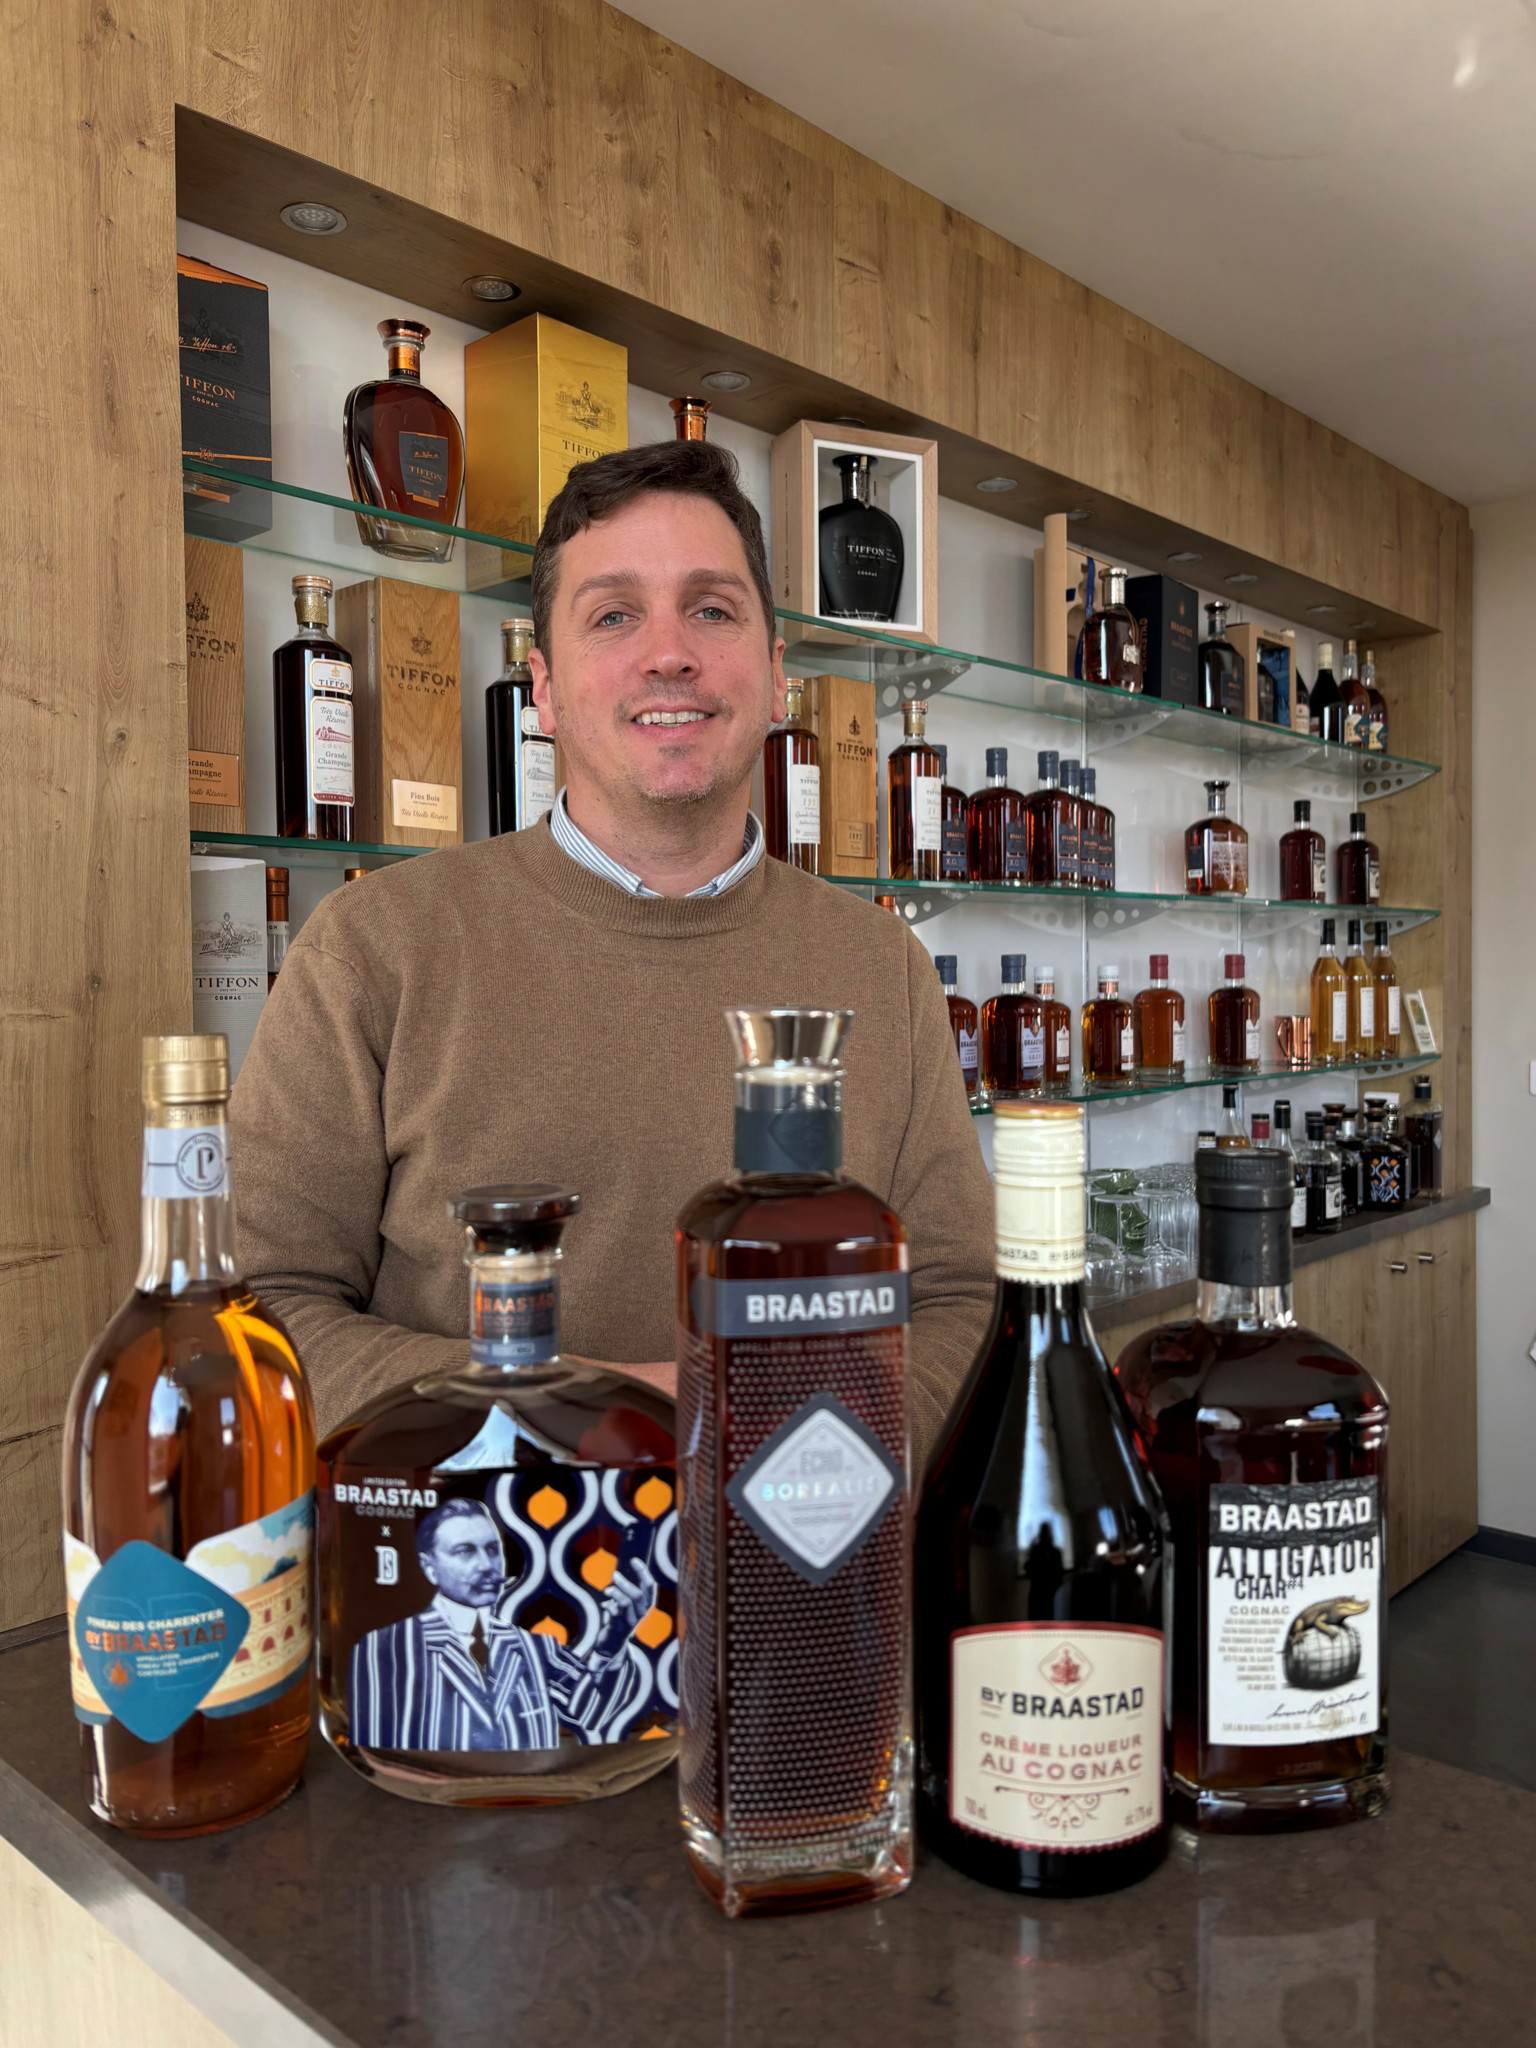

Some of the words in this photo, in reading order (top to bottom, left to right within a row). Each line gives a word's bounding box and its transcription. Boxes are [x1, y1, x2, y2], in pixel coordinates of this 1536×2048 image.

[180, 374, 235, 400] IFFON
[847, 544, 885, 556] TIFFON
[187, 634, 236, 655] FFON
[191, 651, 225, 663] GNAC
[318, 679, 350, 689] TIFFON
[387, 664, 456, 688] TIFFON
[398, 683, 446, 696] COGNAC
[837, 742, 873, 757] TIFFON
[188, 769, 222, 778] mpagne
[195, 977, 259, 988] TIFFON
[747, 1287, 895, 1323] BRAASTAD
[335, 1484, 438, 1508] BRAASTAD
[355, 1504, 416, 1519] COGNAC
[1220, 1496, 1372, 1532] BRAASTAD
[1216, 1541, 1374, 1579] ALLIGATOR
[1235, 1578, 1287, 1600] CHAR
[122, 1621, 145, 1632] DES
[147, 1608, 224, 1631] CHARENTES
[1229, 1605, 1290, 1616] COGNAC
[103, 1621, 226, 1653] BRAASTAD
[981, 1686, 1007, 1704] BY
[1012, 1686, 1144, 1719] BRAASTAD
[1058, 1734, 1143, 1758] LIQUEUR
[981, 1752, 1015, 1774] AU
[1024, 1753, 1143, 1781] COGNAC
